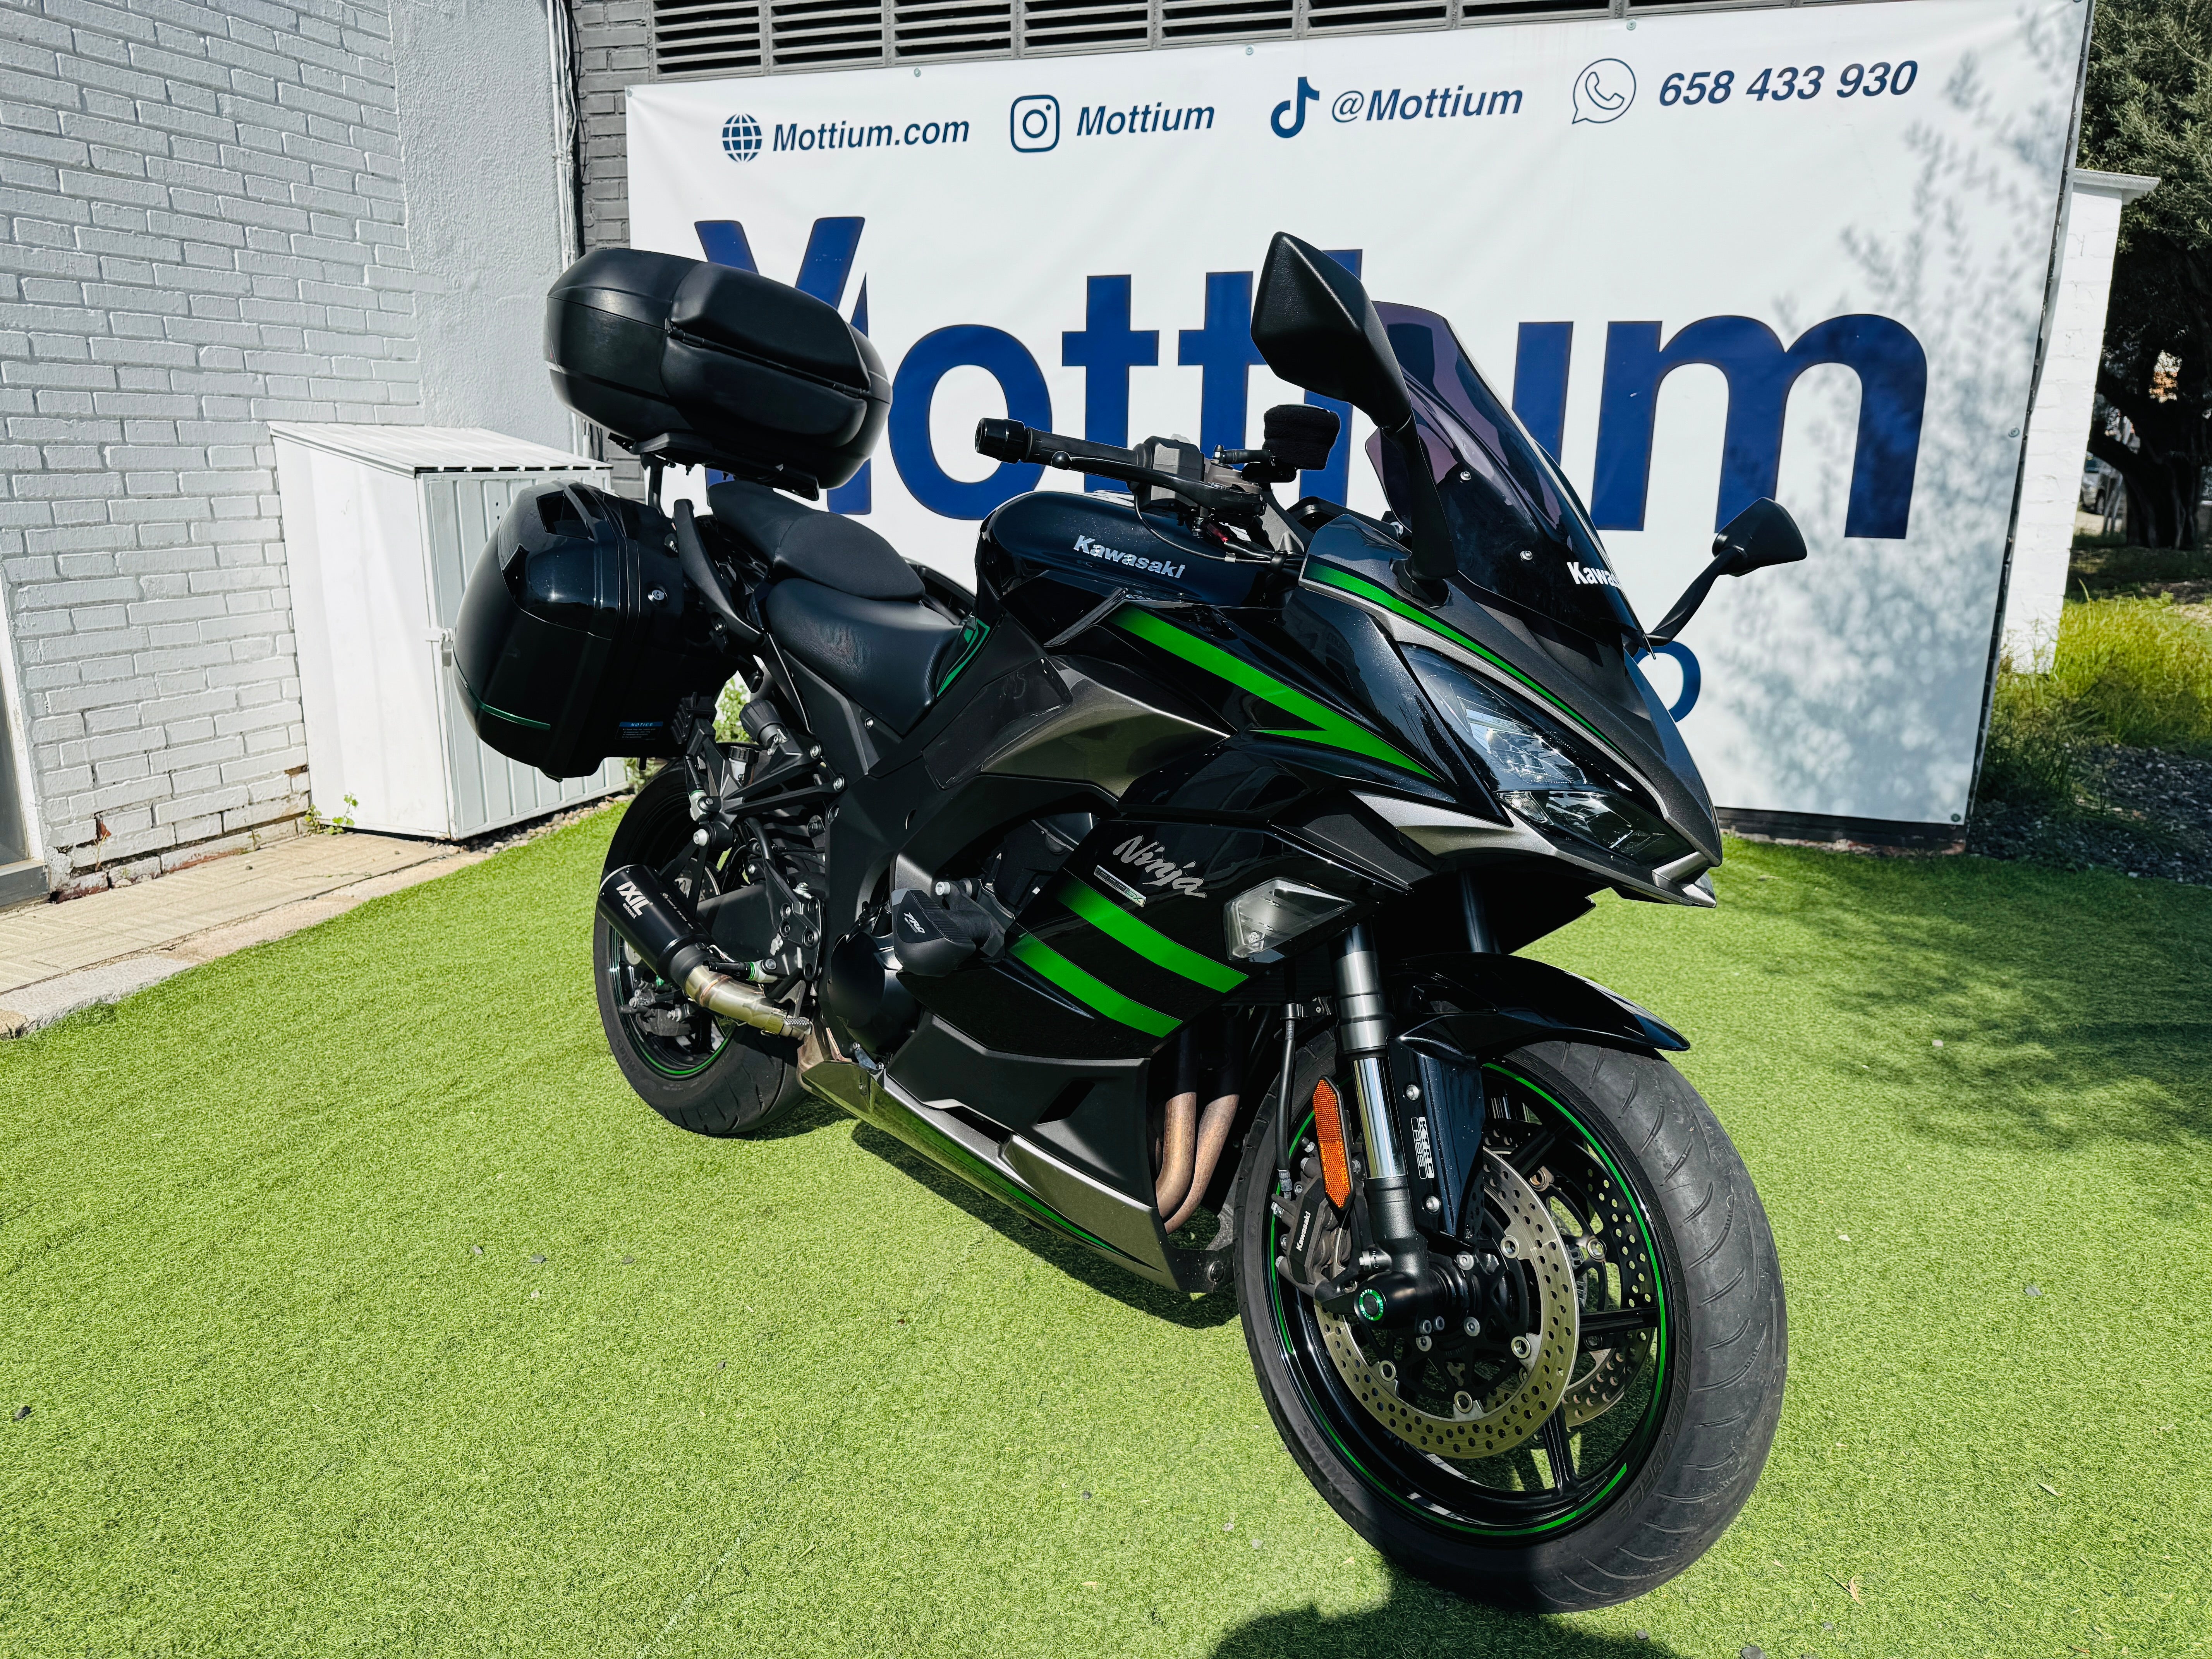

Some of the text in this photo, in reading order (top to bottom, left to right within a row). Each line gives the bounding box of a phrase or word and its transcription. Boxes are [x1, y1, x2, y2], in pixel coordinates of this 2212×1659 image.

[1659, 60, 1918, 106] 658 433 930
[1076, 101, 1215, 136] Mottium
[1331, 85, 1523, 124] @Mottium
[773, 120, 969, 152] Mottium.com
[1073, 534, 1186, 579] Kawasaki
[1113, 835, 1206, 898] Ninja
[616, 881, 650, 915] IXIL
[1413, 1129, 1424, 1167] ABS
[1419, 1120, 1433, 1175] KTRC
[1296, 1211, 1311, 1252] Kawasaki
